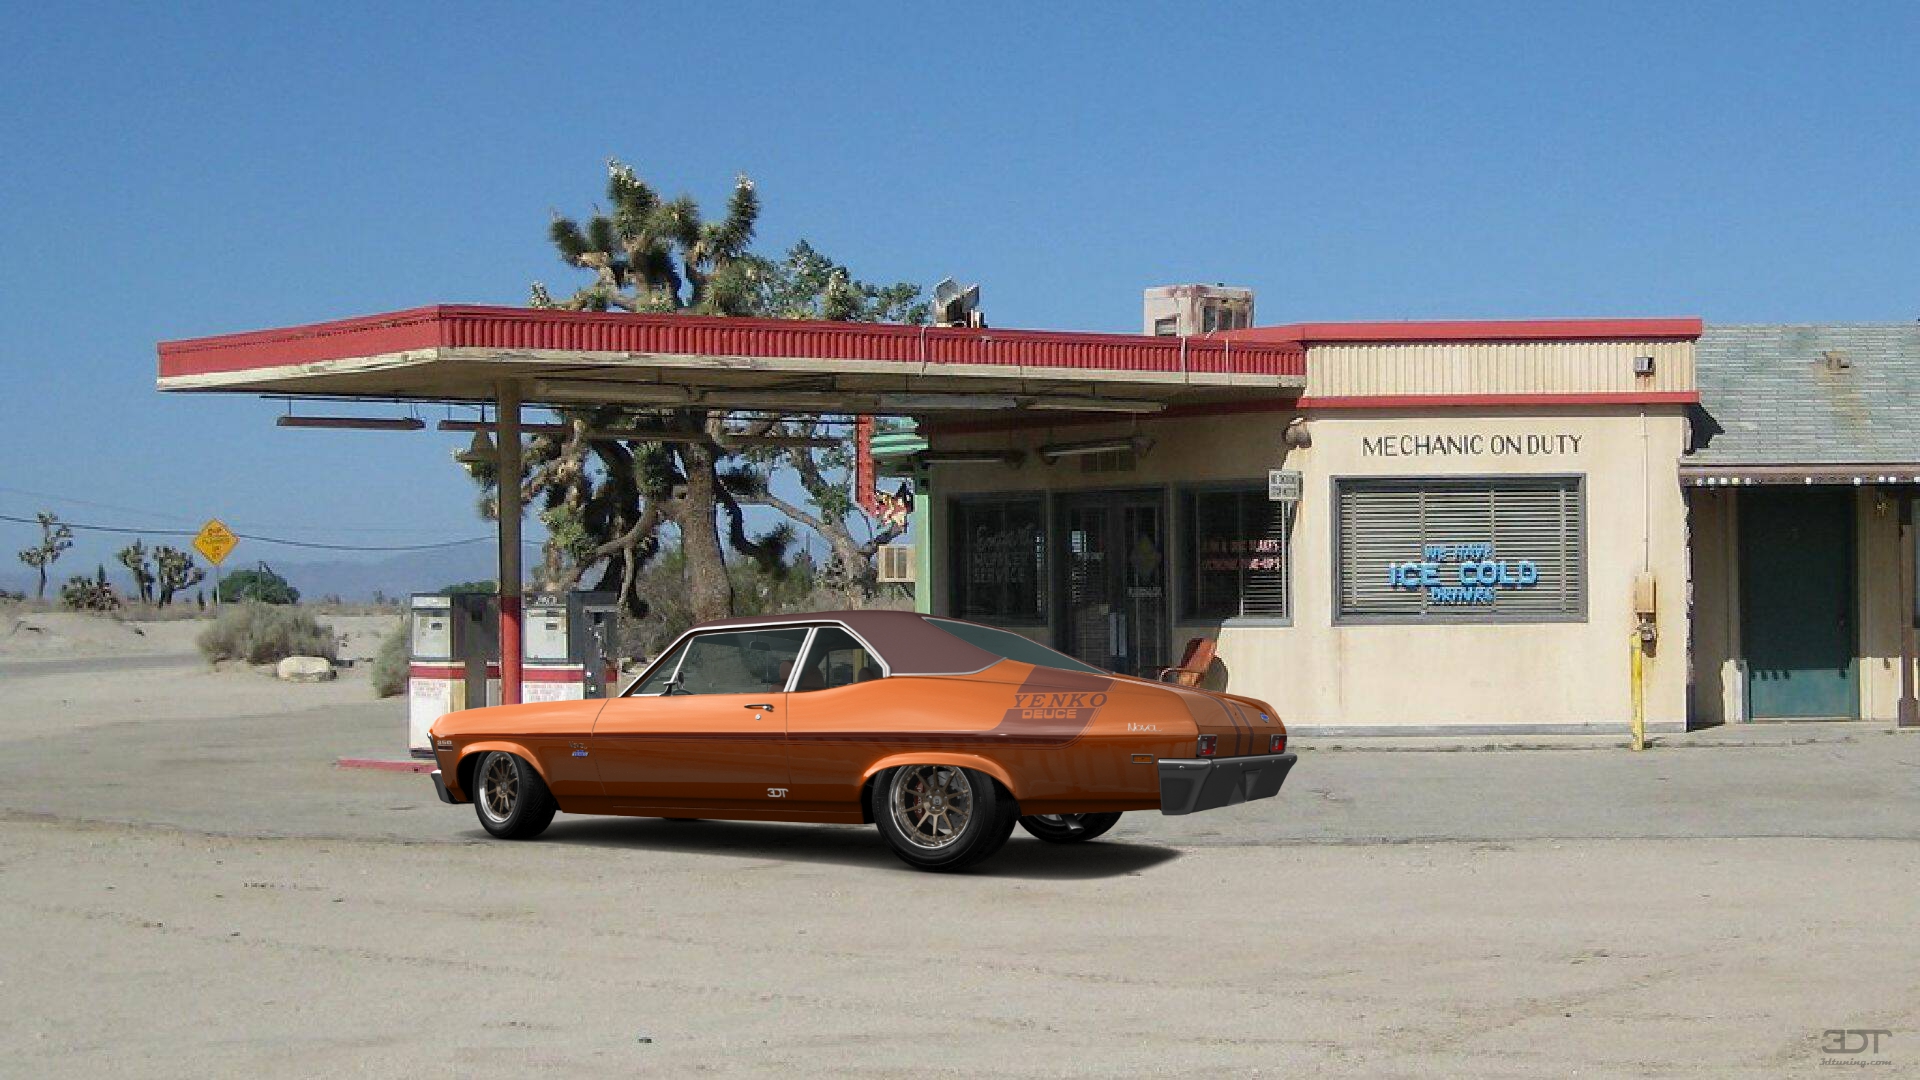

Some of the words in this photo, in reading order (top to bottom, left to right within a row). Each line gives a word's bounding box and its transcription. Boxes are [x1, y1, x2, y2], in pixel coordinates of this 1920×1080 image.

[1362, 434, 1484, 456] MECHANIC
[1490, 435, 1522, 455] ON
[1527, 434, 1582, 455] DUTY
[1388, 562, 1441, 587] ICE
[1459, 560, 1538, 587] COLD
[1012, 692, 1108, 708] YENKO
[1021, 708, 1077, 719] DEUCE
[1127, 722, 1162, 733] Nova
[766, 787, 789, 798] 3DT
